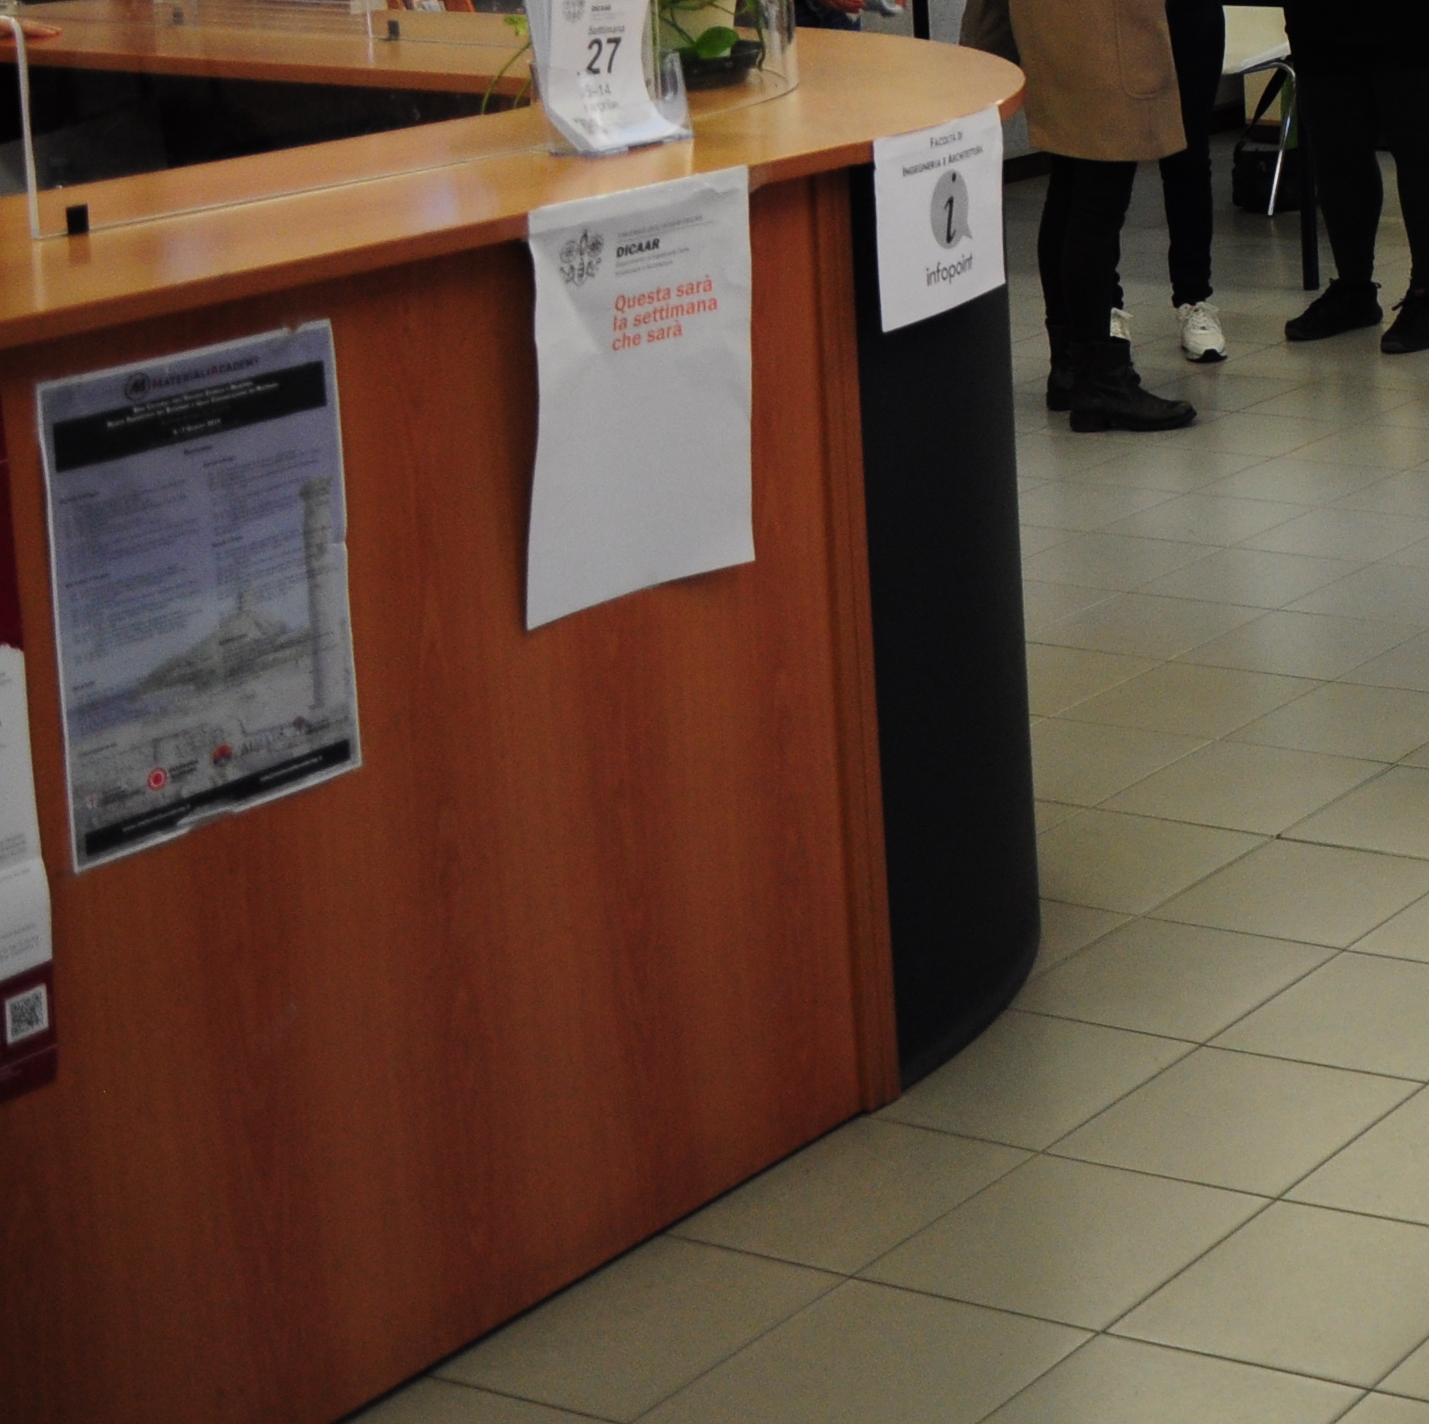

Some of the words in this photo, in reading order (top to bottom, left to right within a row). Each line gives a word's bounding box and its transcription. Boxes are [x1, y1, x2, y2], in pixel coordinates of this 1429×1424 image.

[586, 36, 622, 75] 27
[616, 238, 660, 258] DICAAR
[926, 252, 974, 287] infopoint
[614, 287, 671, 313] Questa
[675, 277, 714, 297] sarà
[613, 315, 629, 332] la
[632, 296, 719, 328] settimana
[611, 333, 642, 351] che
[646, 321, 683, 343] sarà
